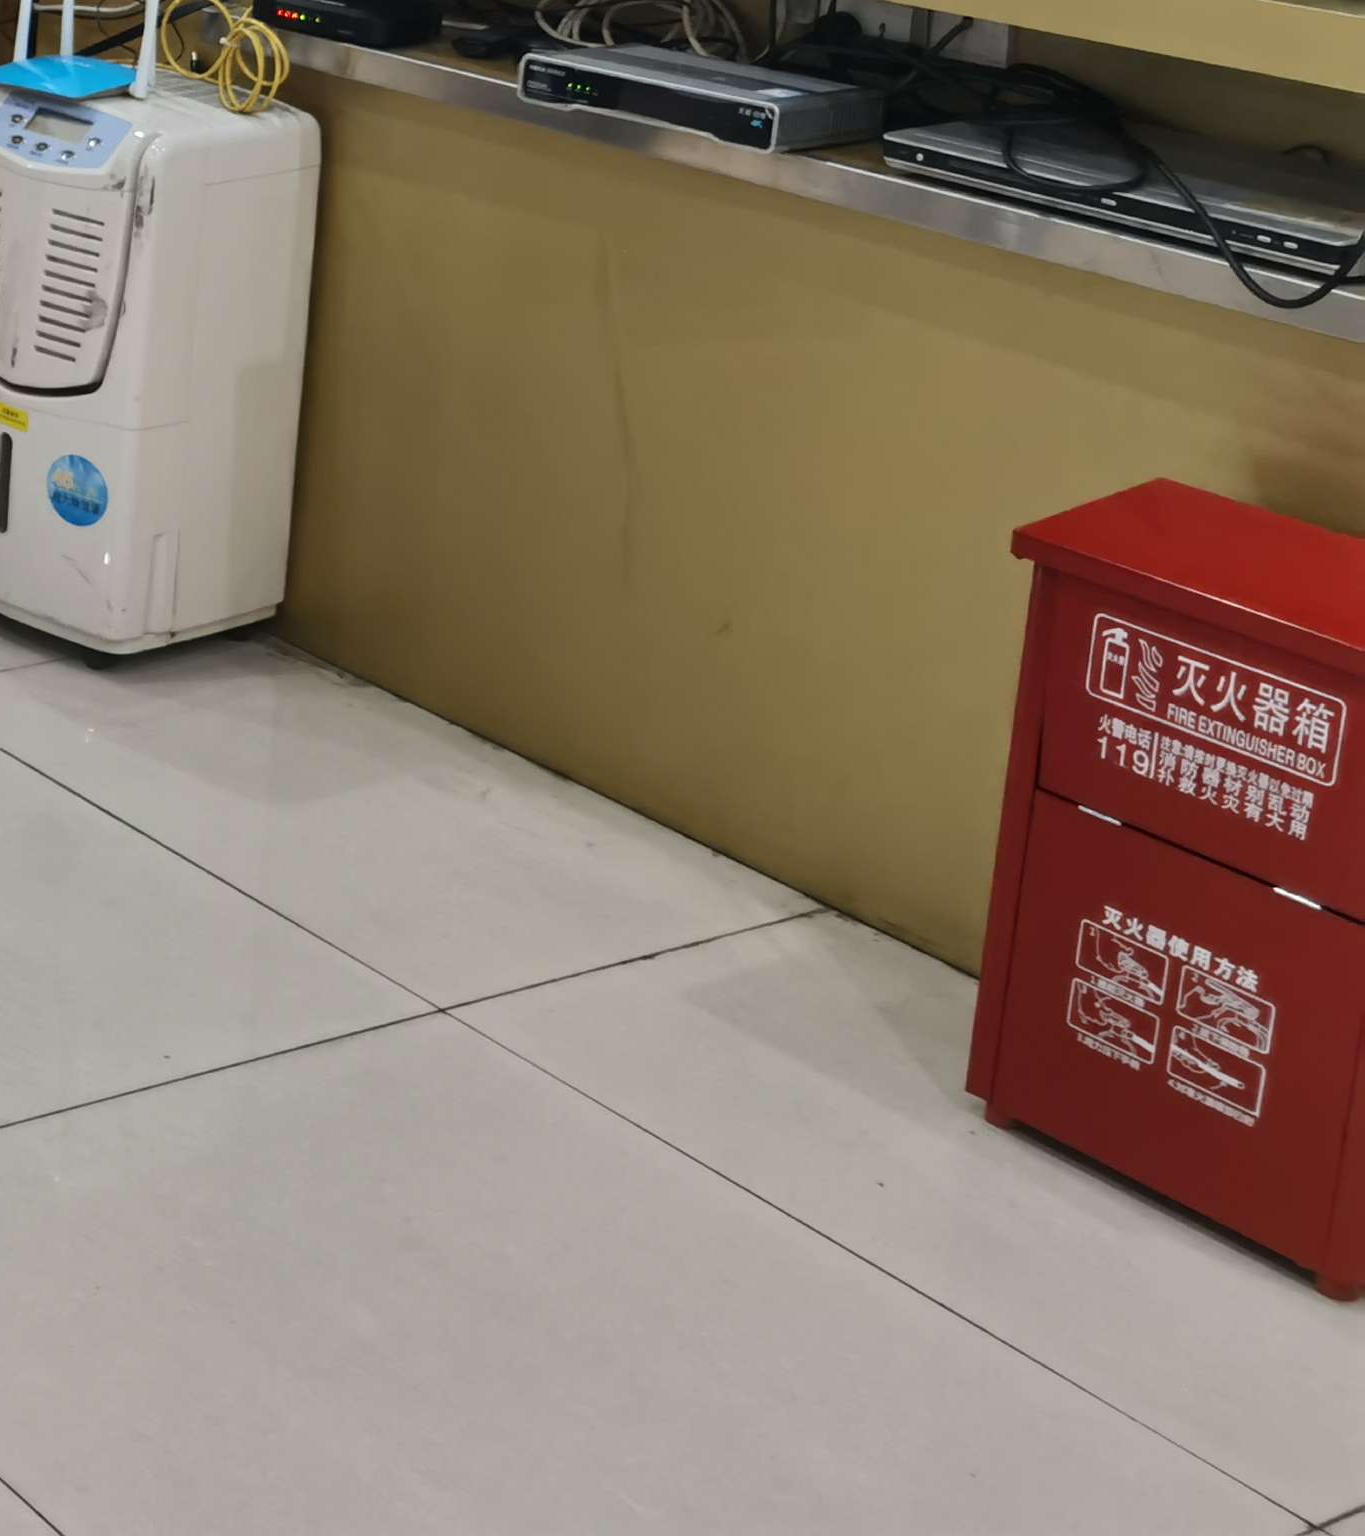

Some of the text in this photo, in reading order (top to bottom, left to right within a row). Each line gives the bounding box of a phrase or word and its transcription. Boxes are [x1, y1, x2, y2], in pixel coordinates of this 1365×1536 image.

[1097, 714, 1153, 751] 火警电话
[1166, 702, 1327, 779] FIRE EXTINGUISHER BOX
[1171, 655, 1337, 756] 灭火器箱
[1096, 735, 1151, 777] 119
[1158, 751, 1312, 824] 消防器材别乱动
[1157, 766, 1309, 841] 扑救火灾有大用
[1101, 905, 1259, 993] 灭火器使用方法
